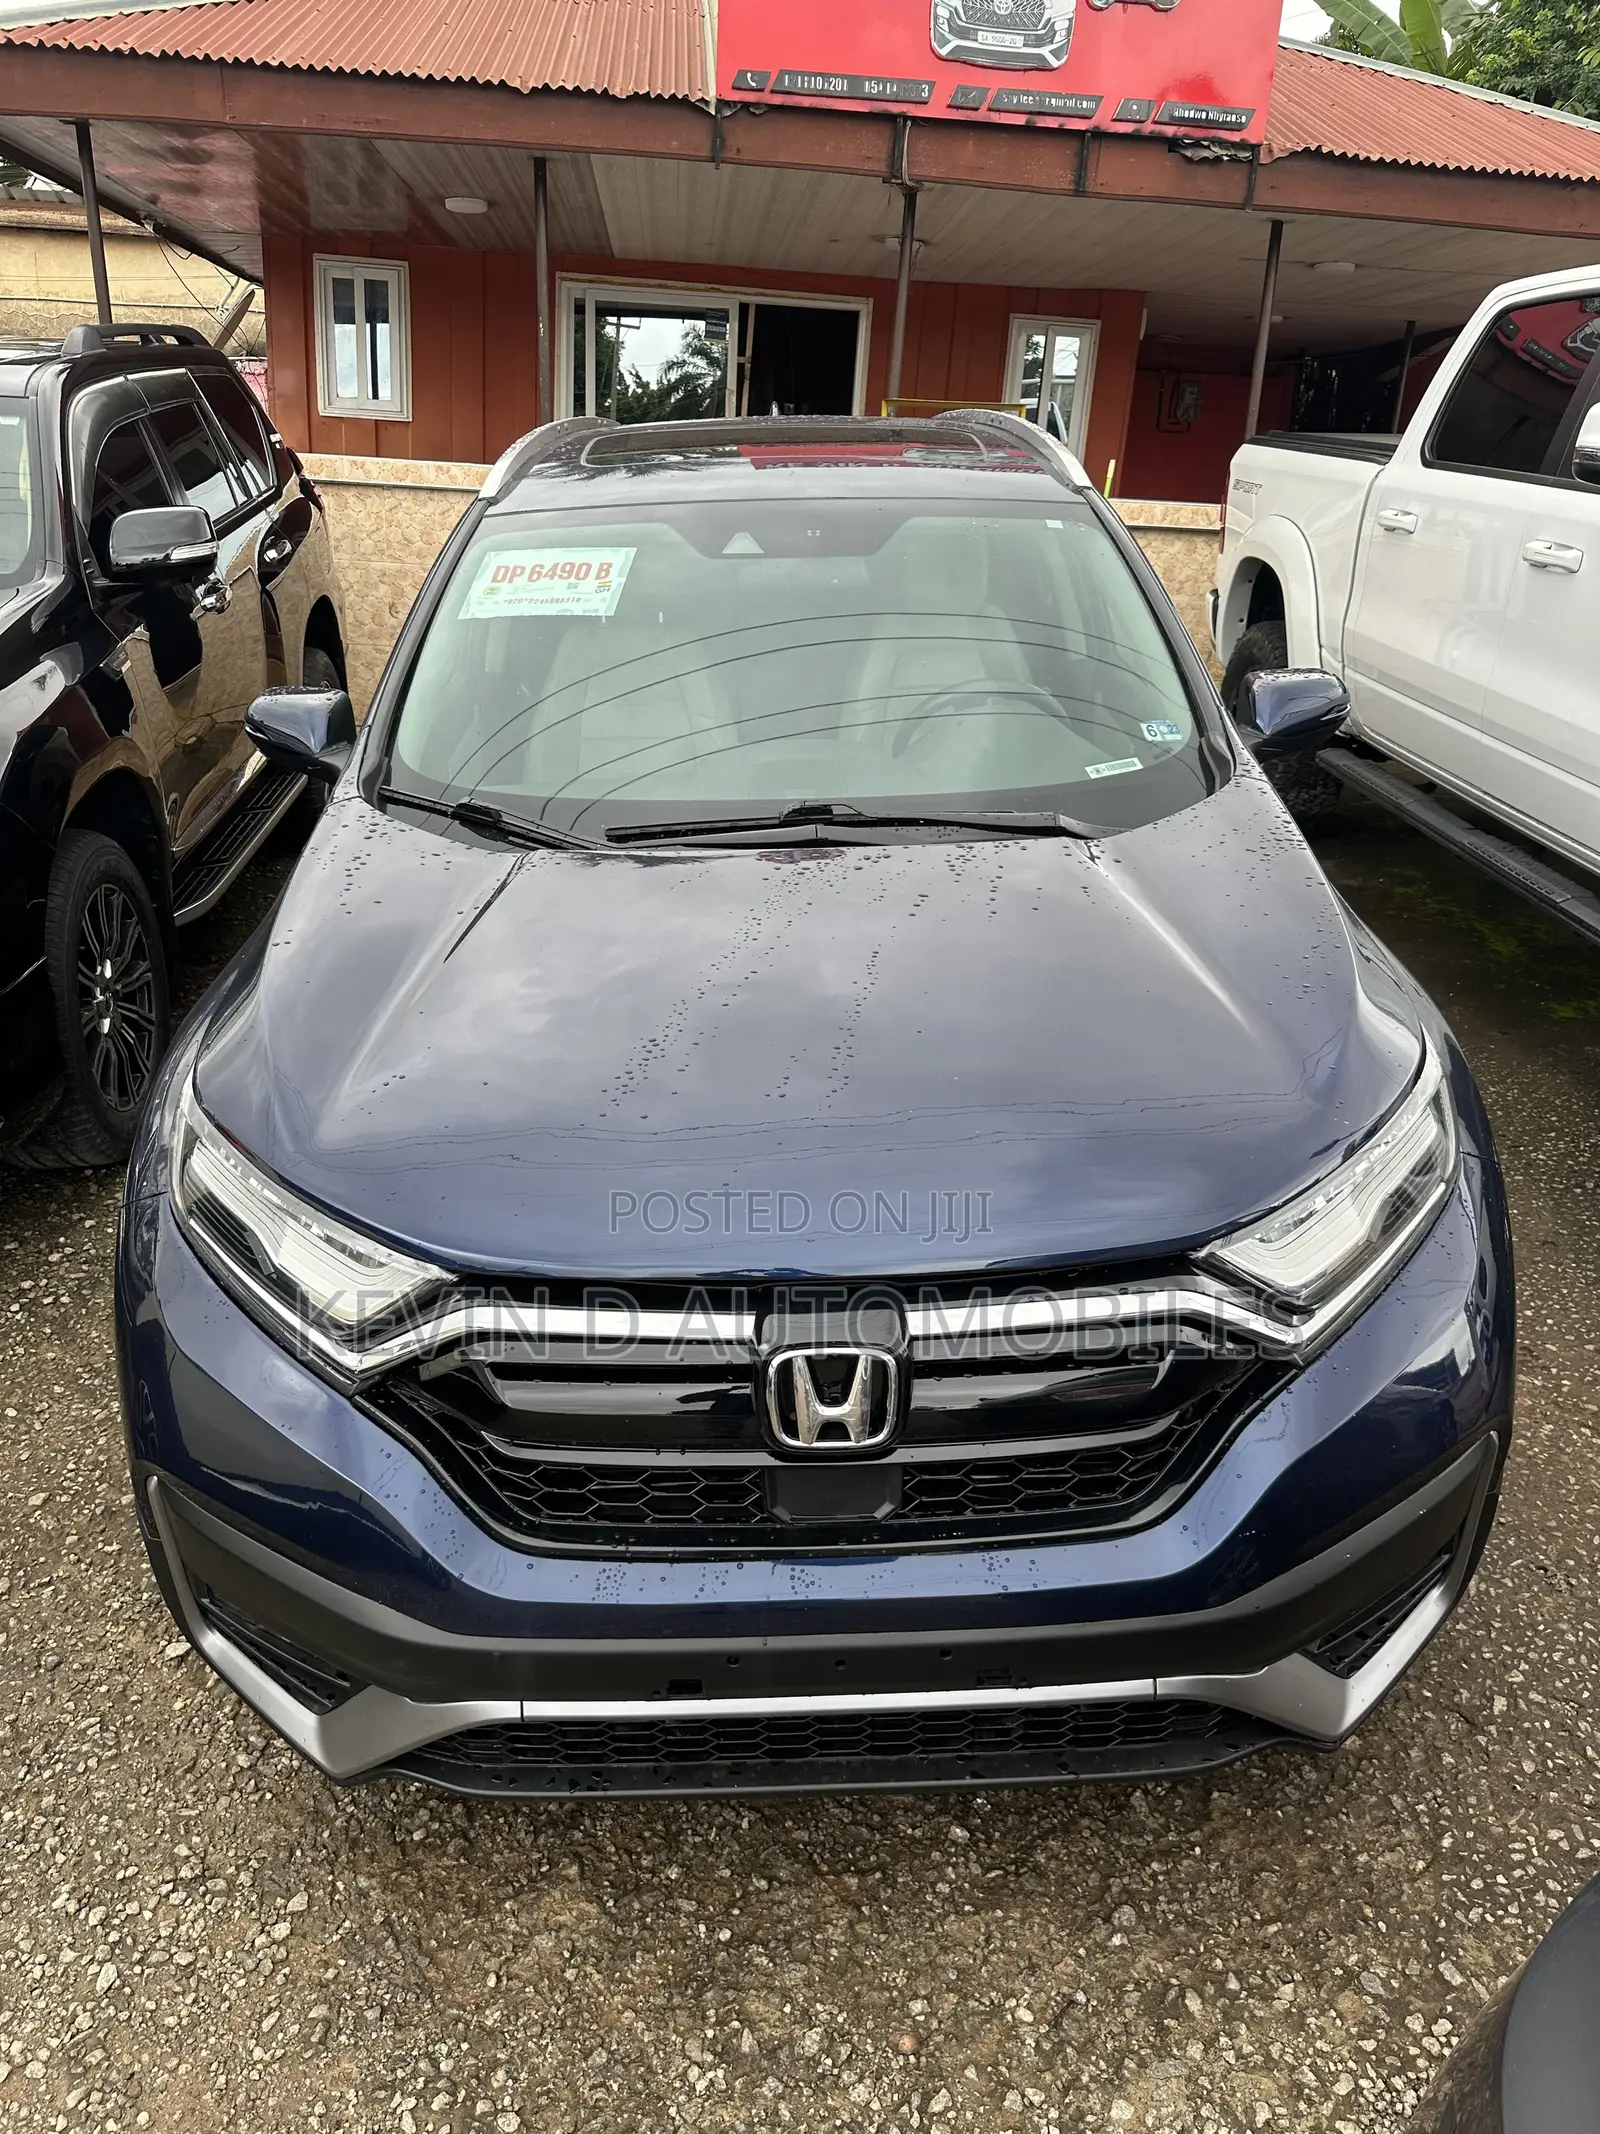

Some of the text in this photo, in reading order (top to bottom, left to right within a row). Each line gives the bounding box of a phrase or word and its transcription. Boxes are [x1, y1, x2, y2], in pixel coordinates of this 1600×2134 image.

[490, 562, 613, 583] DP 6490 B
[1146, 724, 1158, 737] 6
